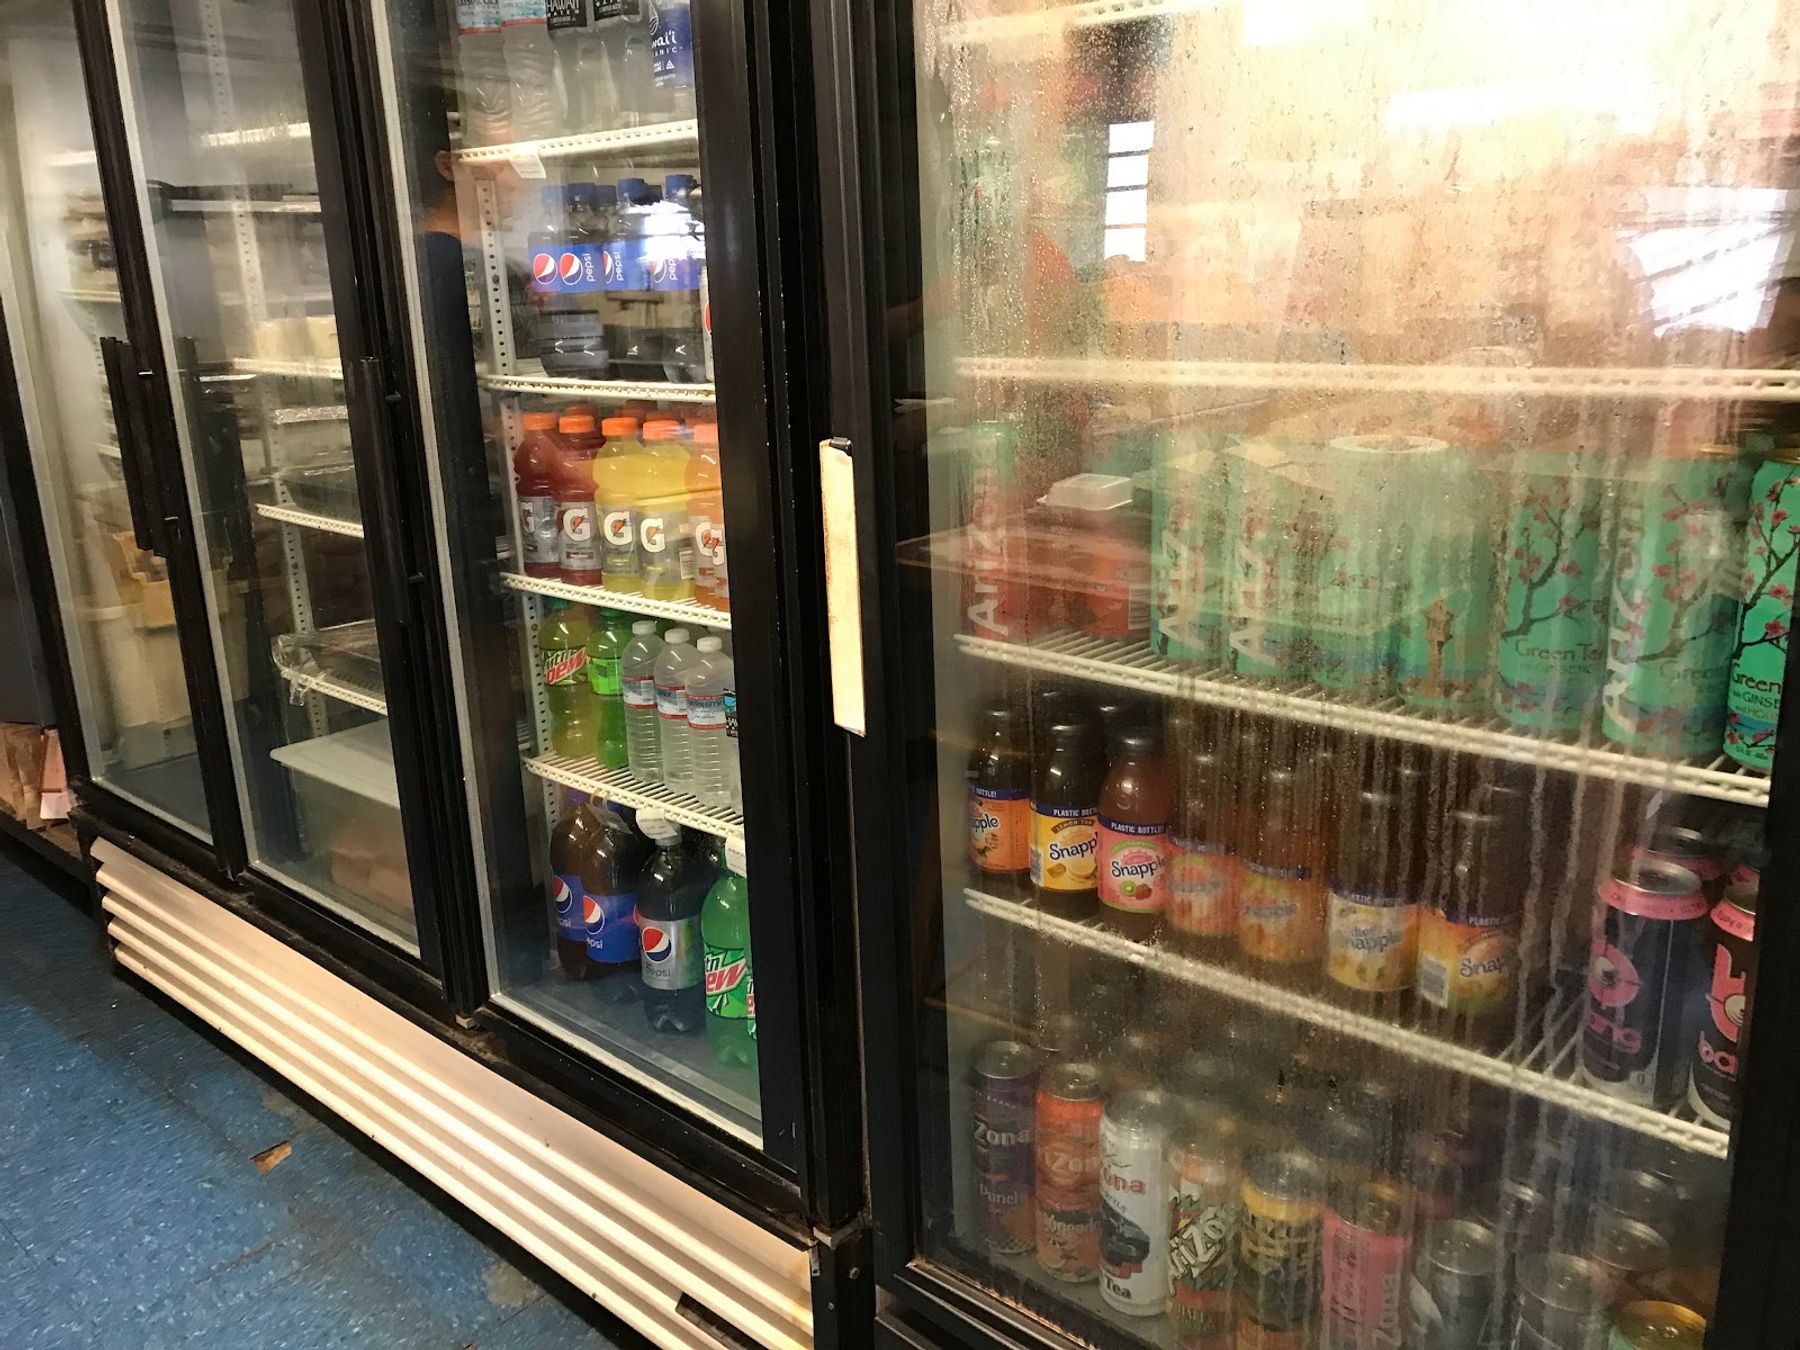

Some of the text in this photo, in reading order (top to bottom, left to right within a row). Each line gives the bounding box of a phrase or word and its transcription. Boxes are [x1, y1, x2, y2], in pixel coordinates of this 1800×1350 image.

[582, 253, 596, 282] pepsi
[615, 251, 625, 281] pepsi
[563, 508, 591, 542] G
[604, 511, 633, 546] G
[640, 518, 665, 553] G
[1731, 662, 1782, 695] Green
[1742, 691, 1781, 709] GINSE
[974, 813, 999, 833] pple
[1053, 807, 1098, 818] PLASTIC BOTT
[1111, 821, 1136, 834] PLASTIC
[1049, 831, 1098, 861] Snapp
[1111, 855, 1165, 879] Snapple
[705, 952, 725, 974] tn
[706, 959, 745, 994] ew
[973, 1117, 1035, 1147] Zona
[1102, 1166, 1146, 1196] ona
[1104, 1273, 1133, 1301] Tea
